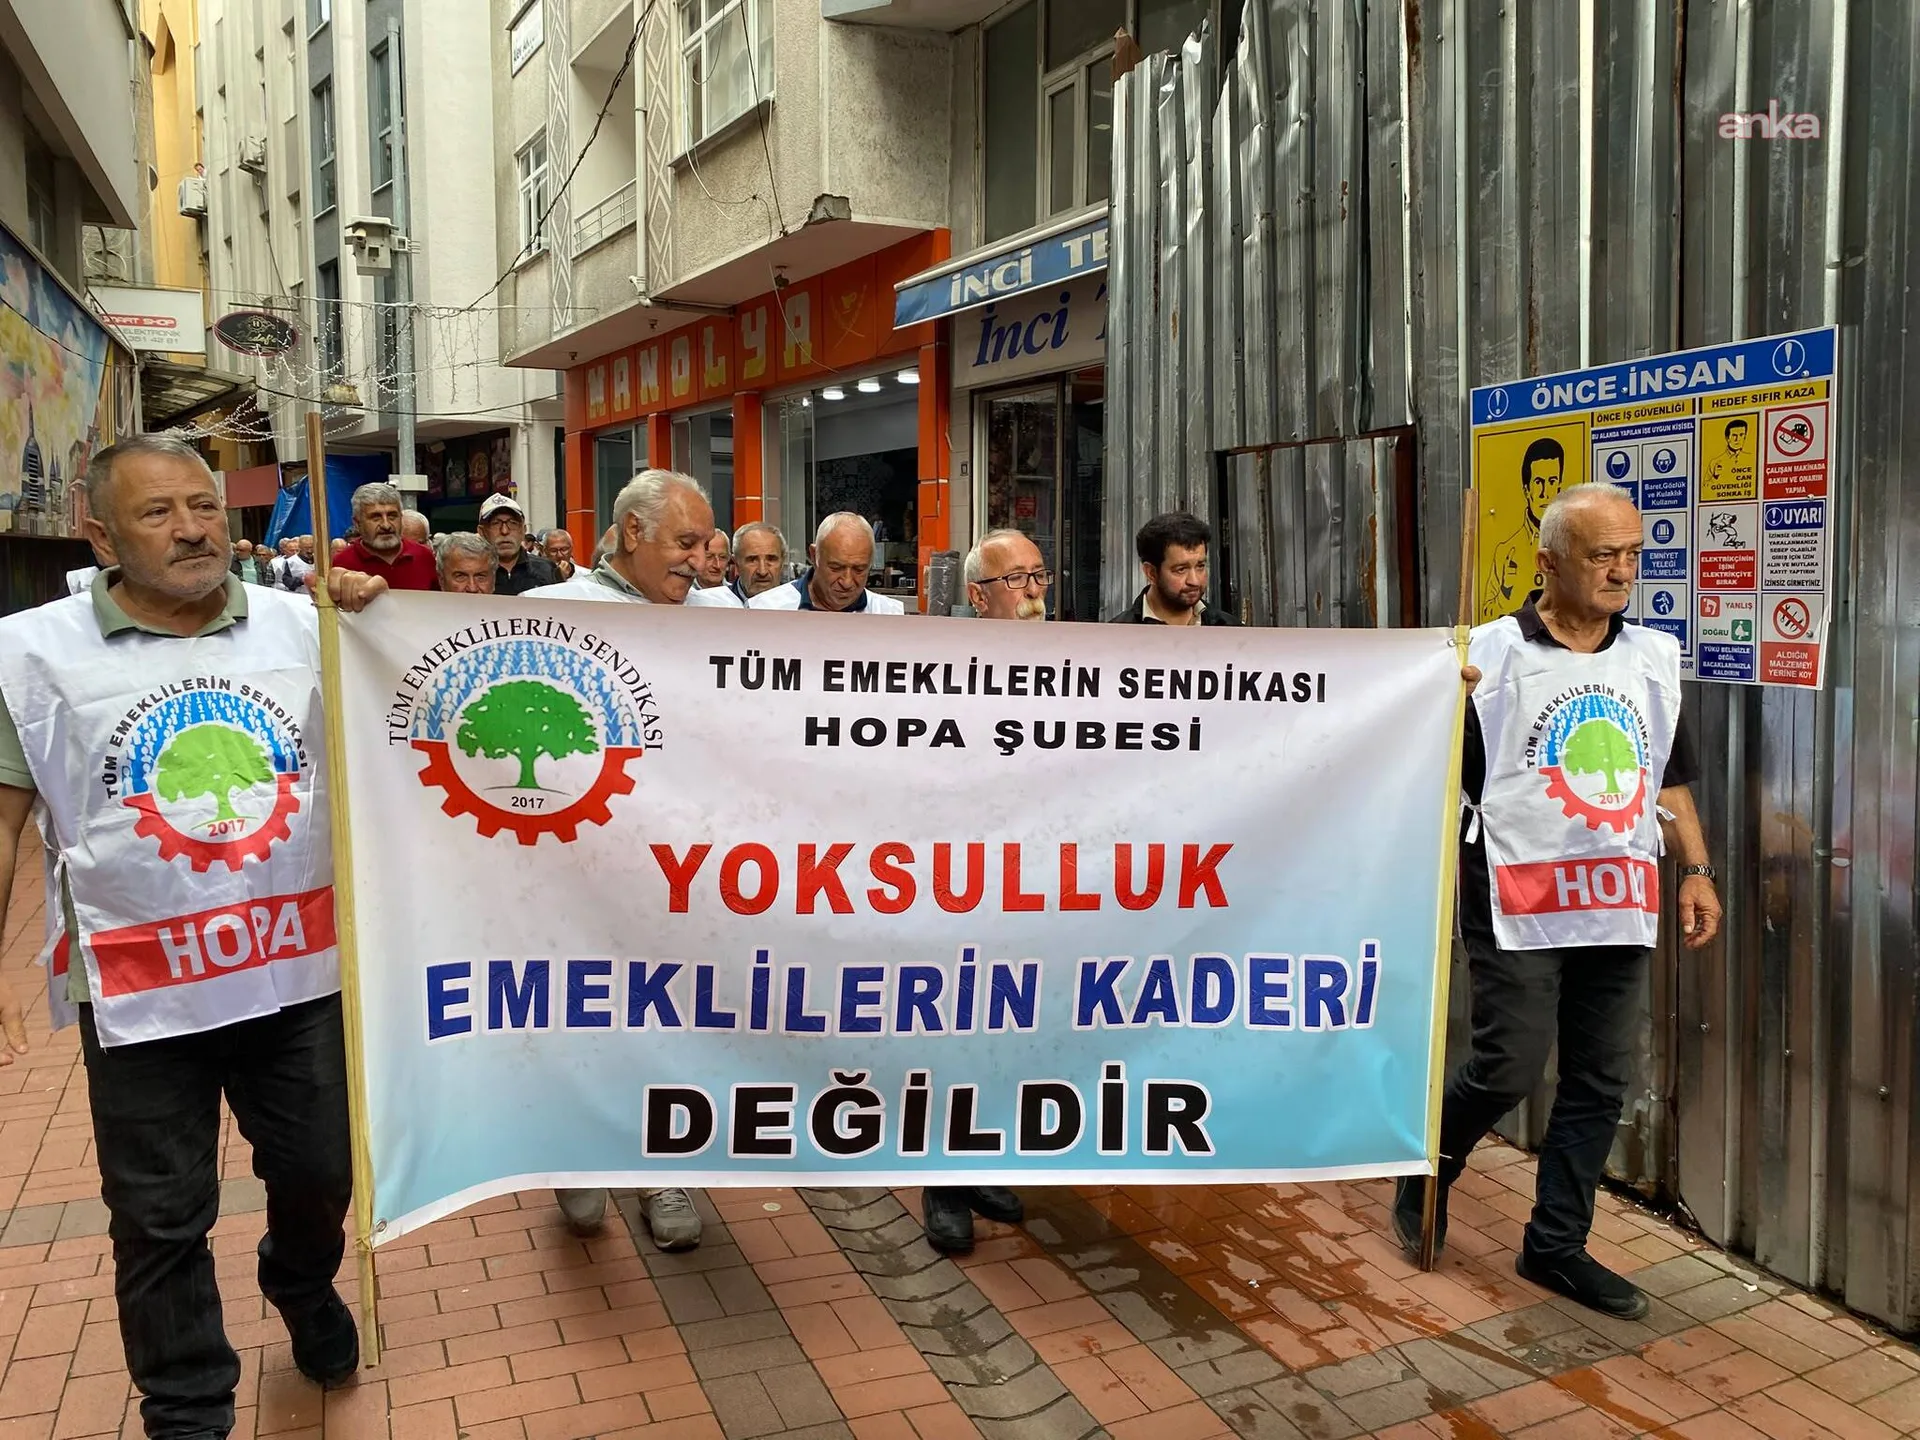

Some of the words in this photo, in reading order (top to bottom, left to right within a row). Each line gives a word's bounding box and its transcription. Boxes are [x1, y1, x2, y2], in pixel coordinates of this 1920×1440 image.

[951, 248, 1033, 307] İNCİ
[143, 317, 175, 327] SHOP
[972, 291, 1070, 367] İnci
[587, 291, 812, 420] MANOLYA
[1531, 375, 1617, 410] ÖNCE
[1628, 354, 1745, 397] İNSAN
[1712, 395, 1747, 408] HEDEF
[1751, 391, 1781, 403] SIFIR
[1784, 387, 1815, 399] KAZA
[1597, 412, 1621, 423] ÖNCE
[1623, 409, 1632, 421] İŞ
[1634, 403, 1685, 418] GÜVENLİĞİ
[1600, 430, 1619, 439] ALANDA
[1621, 428, 1641, 437] YAPILAN
[1652, 424, 1671, 433] UYGUN
[1672, 421, 1694, 431] KİŞİSEL
[1766, 465, 1793, 475] ÇALIŞAN
[1793, 463, 1826, 472] MAKİNADA
[1711, 482, 1752, 491] GÜVENLİĞİ
[1768, 477, 1788, 485] BAKIM
[1789, 476, 1798, 484] VE
[1798, 474, 1823, 482] ONARIM
[1656, 490, 1682, 498] Kulaklık
[1716, 490, 1742, 498] SONRA
[1744, 489, 1751, 497] İŞ
[1785, 487, 1806, 495] YAPMA
[1783, 507, 1822, 525] UYARI
[1649, 552, 1679, 560] EMNİYET
[1701, 555, 1754, 563] ELEKTRİKÇİNİN
[1702, 571, 1752, 579] ELEKTRİKÇİYE
[1725, 602, 1752, 612] YANLIŞ
[1702, 628, 1729, 636] DOĞRU
[1704, 645, 1719, 653] YÜKÜ
[1718, 653, 1735, 661] DEĞİL
[1776, 650, 1808, 660] ALDIĞIN
[1768, 669, 1796, 678] YERİNE
[1798, 671, 1812, 679] KOY
[1769, 660, 1813, 670] MALZEMEYİ
[385, 691, 414, 746] TÜM
[402, 616, 577, 691] EMEKLİLERİN
[579, 633, 664, 751] SENDİKASI
[709, 650, 802, 692] TÜM
[823, 656, 1101, 698] EMEKLİLERİN
[1118, 662, 1327, 703] SENDİKASI
[109, 675, 232, 748] EMEKLİLERİN
[239, 684, 308, 768] SENDİKASI
[1525, 736, 1538, 768] TÜM
[1536, 683, 1615, 732] EMEKLİLERİN
[804, 716, 967, 748] HOPA
[993, 716, 1202, 756] ŞUBESİ
[101, 754, 119, 799] TÜM
[511, 796, 545, 810] 2017
[207, 819, 246, 837] 2017
[649, 841, 1235, 915] YOKSULLUK
[157, 901, 307, 979] HOPA
[425, 946, 1036, 1041] EMEKLİLERİN
[1076, 941, 1378, 1029] KADERİ
[644, 1064, 1212, 1155] DEĞİLDİR
